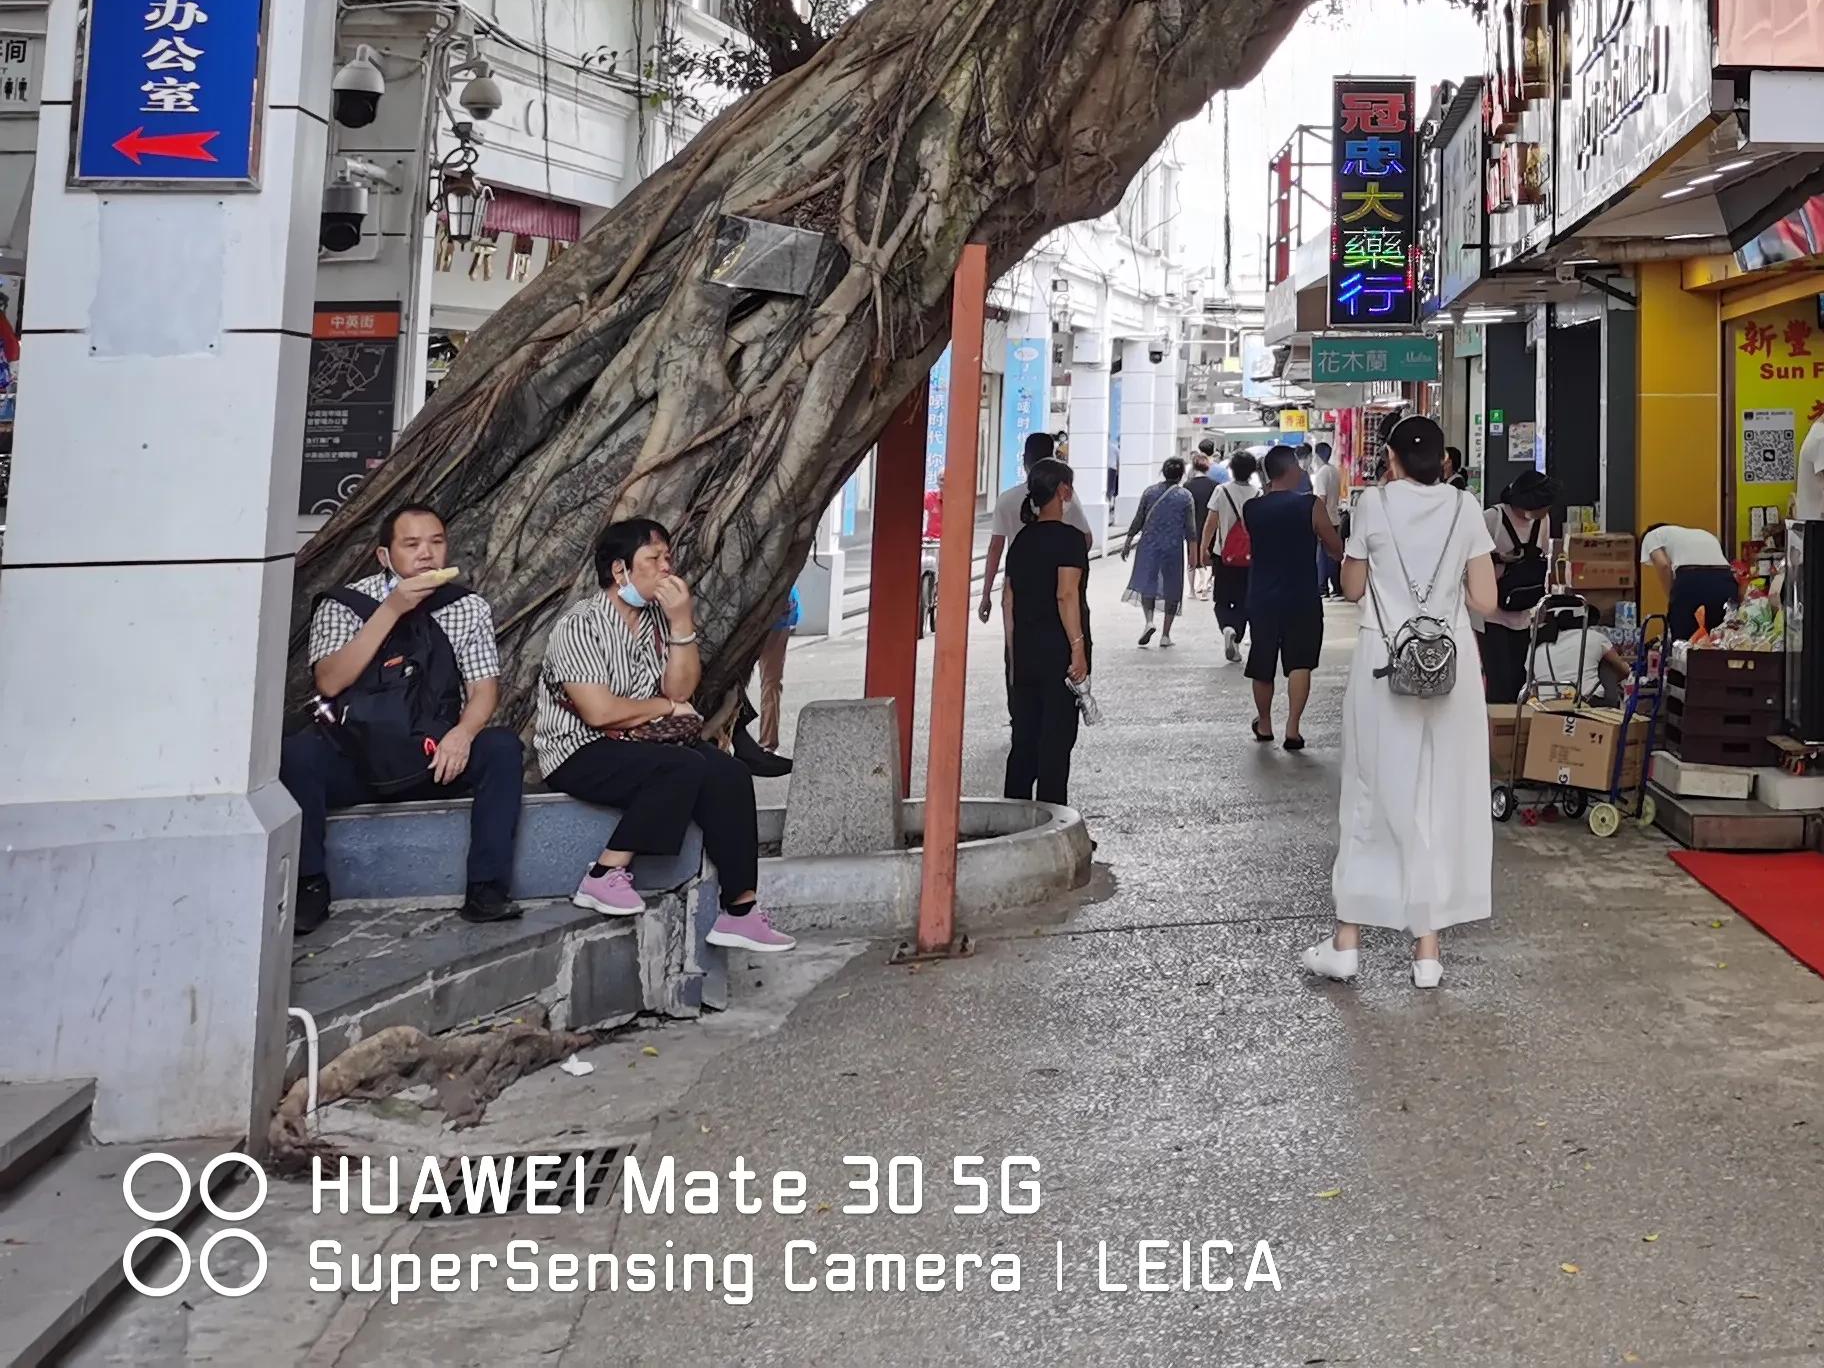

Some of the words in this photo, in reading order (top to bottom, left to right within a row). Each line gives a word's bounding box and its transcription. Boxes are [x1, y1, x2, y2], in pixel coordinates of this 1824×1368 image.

[0, 39, 27, 64] 间
[1338, 92, 1406, 316] 冠忠大藥行
[1317, 349, 1389, 374] 花木蘭
[1759, 362, 1805, 380] Sun
